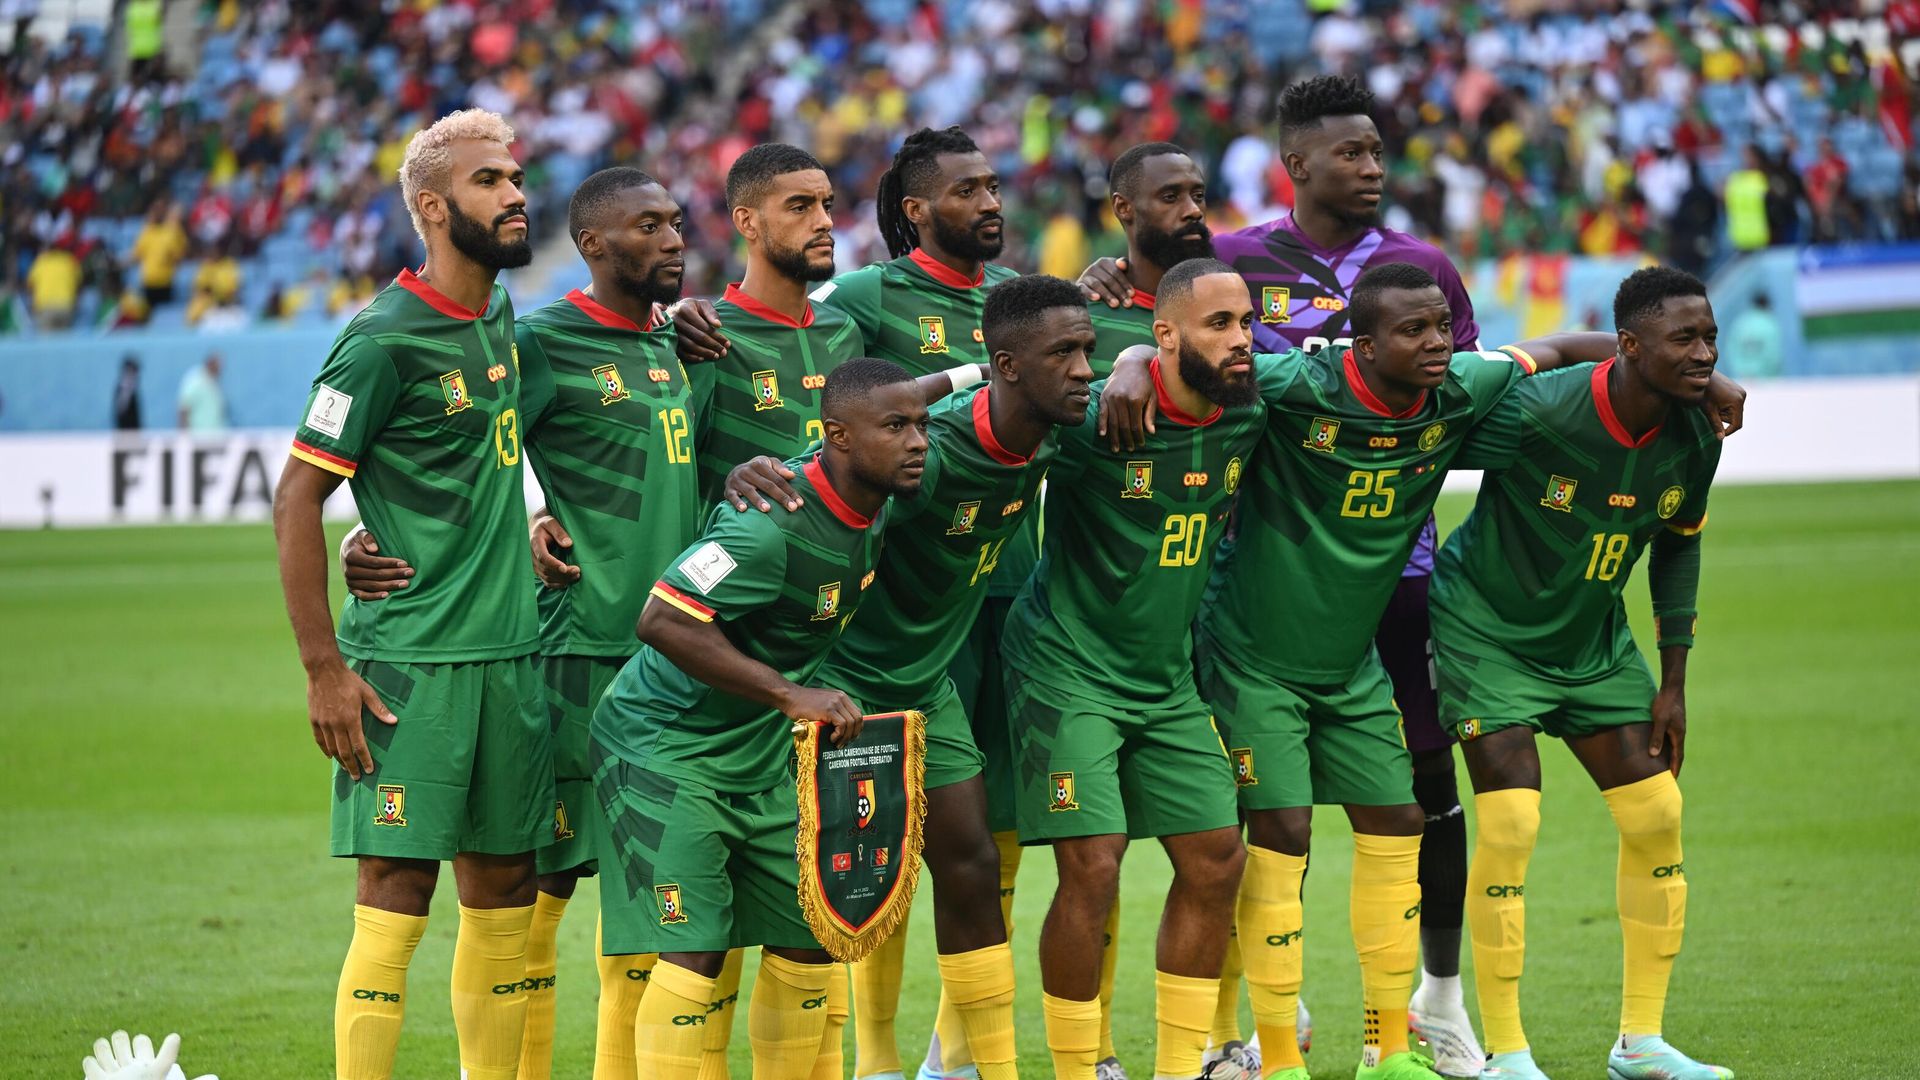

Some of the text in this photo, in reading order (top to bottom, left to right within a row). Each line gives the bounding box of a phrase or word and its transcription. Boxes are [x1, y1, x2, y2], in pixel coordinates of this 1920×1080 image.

[1312, 296, 1344, 312] one
[488, 363, 507, 383] one
[647, 368, 671, 382] one
[802, 374, 826, 389] one
[495, 408, 518, 470] 13
[658, 408, 691, 464] 12
[1368, 436, 1398, 448] one
[111, 447, 273, 508] FIFA
[1183, 471, 1208, 487] one
[1341, 469, 1400, 518] 25
[1607, 493, 1636, 508] one
[1002, 499, 1024, 517] one
[1159, 513, 1207, 567] 20
[969, 537, 1006, 587] 14
[1585, 532, 1629, 581] 18
[874, 745, 880, 754] DE
[880, 743, 900, 753] FOOTBALL
[828, 759, 850, 770] CAMEROON
[849, 757, 869, 767] FOOTBALL
[1266, 927, 1303, 947] on
[626, 968, 652, 982] on
[352, 988, 400, 1003] one
[492, 981, 526, 995] on
[801, 994, 827, 1010] on
